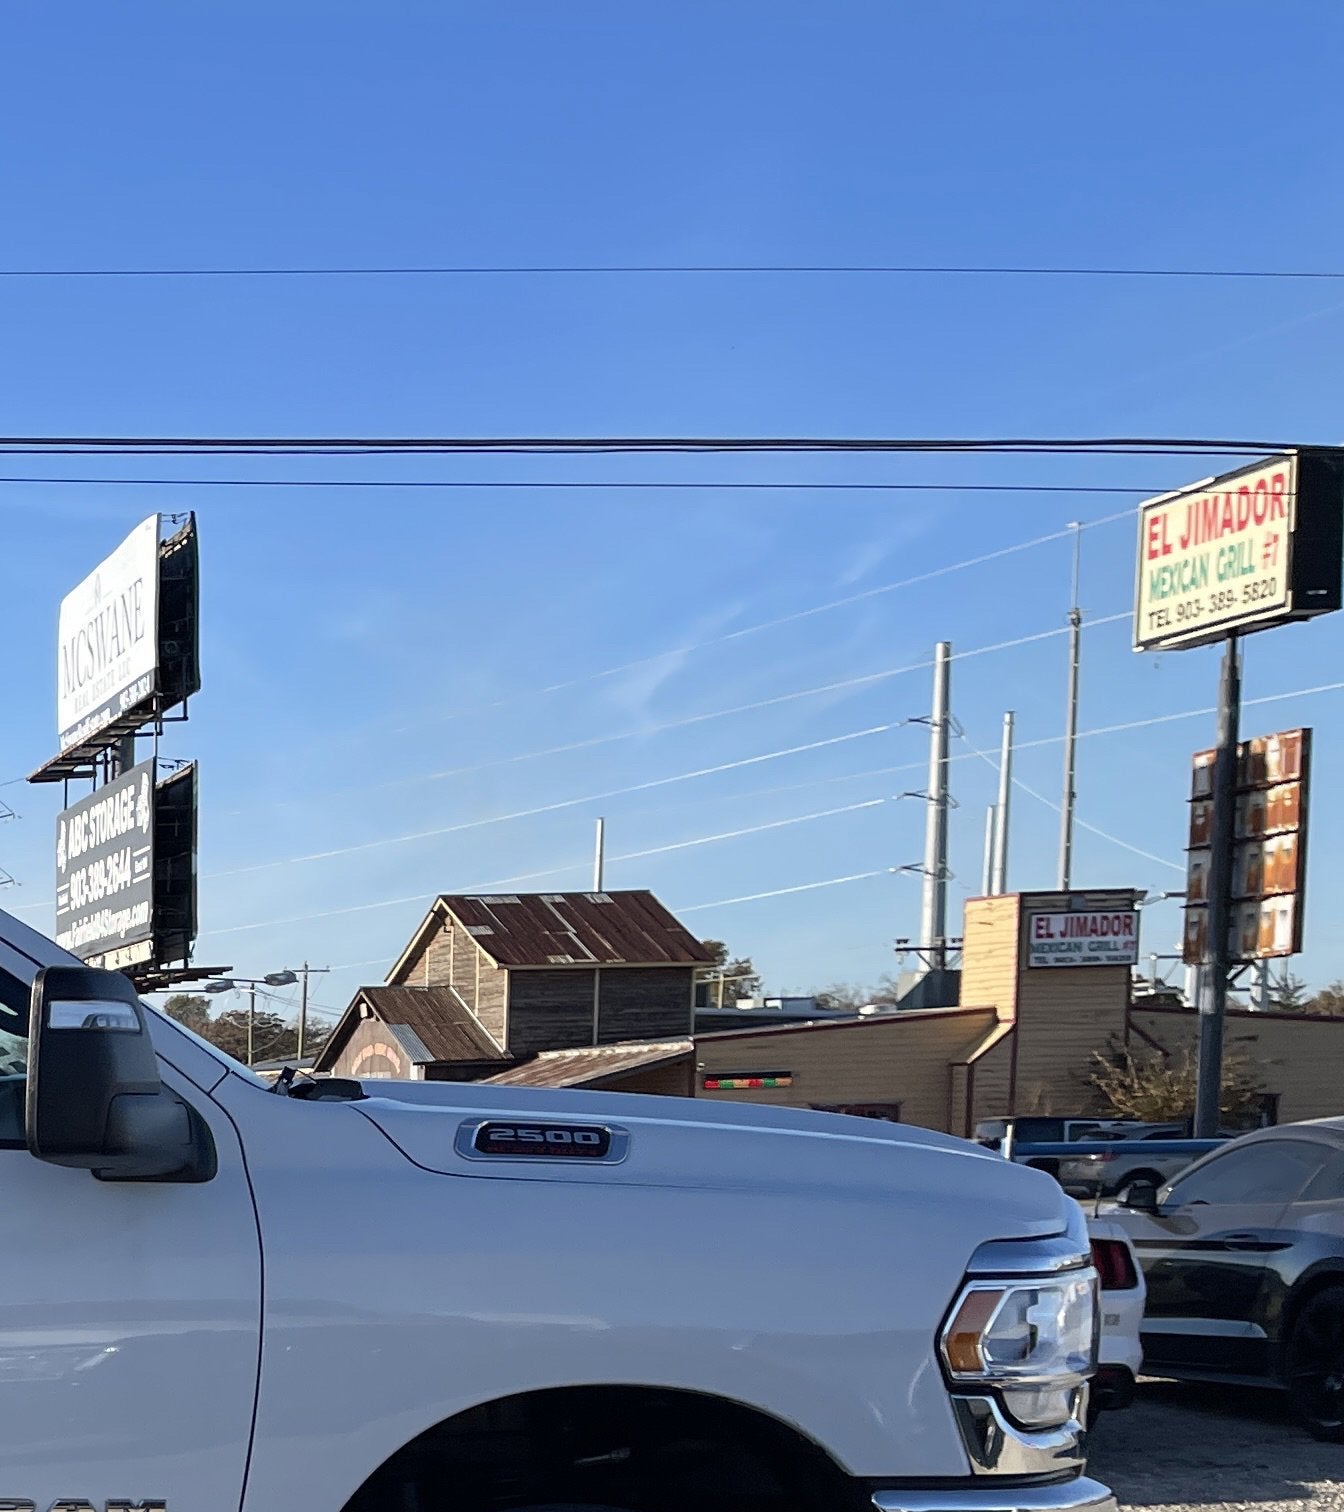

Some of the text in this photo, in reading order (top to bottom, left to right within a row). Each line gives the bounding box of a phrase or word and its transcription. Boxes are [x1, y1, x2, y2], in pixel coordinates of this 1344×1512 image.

[1148, 473, 1287, 560] EL JIMADOR
[1149, 552, 1210, 603] MEXICAN
[1216, 539, 1256, 583] GRILL
[62, 577, 146, 699] MCSWANE
[1148, 609, 1173, 631] TEL
[68, 784, 135, 859] ABC STORAGE
[70, 846, 132, 910] 903-389-2644
[1035, 914, 1133, 939] EL JIMADOR
[488, 1128, 601, 1144] 2500
